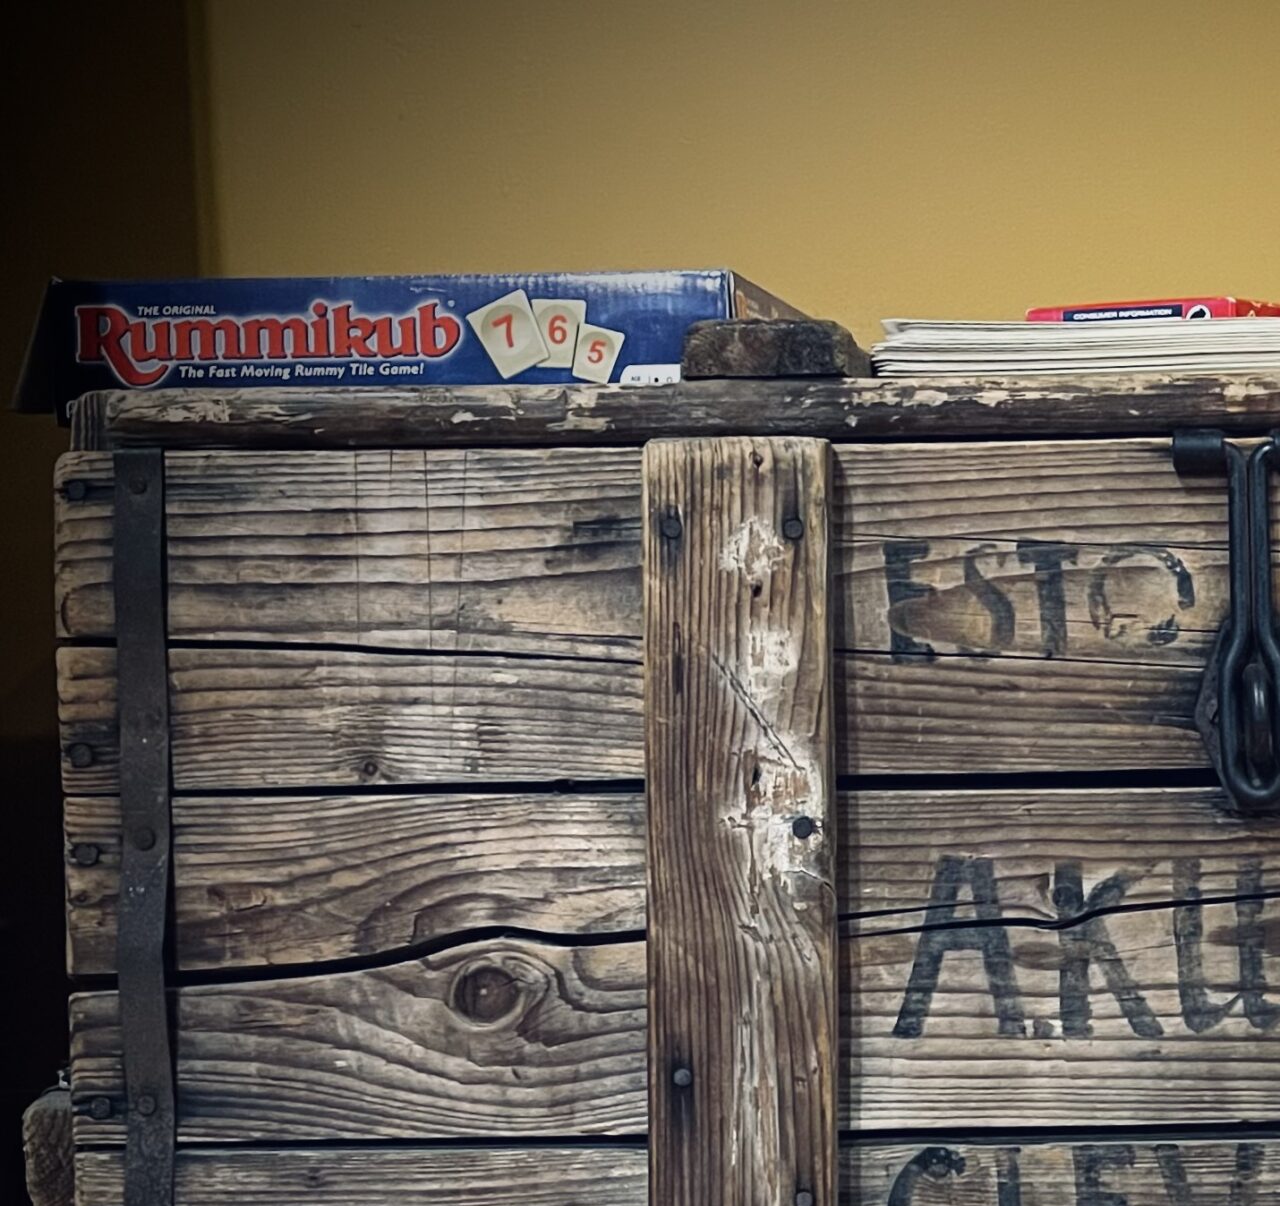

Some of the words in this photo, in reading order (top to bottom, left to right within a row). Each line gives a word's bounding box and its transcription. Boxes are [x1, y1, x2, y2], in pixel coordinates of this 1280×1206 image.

[137, 305, 161, 316] THE
[162, 304, 216, 316] ORIGINAL
[76, 299, 462, 386] Rummikub
[492, 313, 515, 348] 7
[547, 314, 568, 344] 6
[586, 339, 607, 363] 5
[179, 364, 205, 379] The
[208, 364, 237, 378] Fast
[241, 363, 290, 380] Moving
[295, 363, 346, 379] Rummy
[350, 362, 376, 376] Tile
[379, 361, 425, 376] Game!
